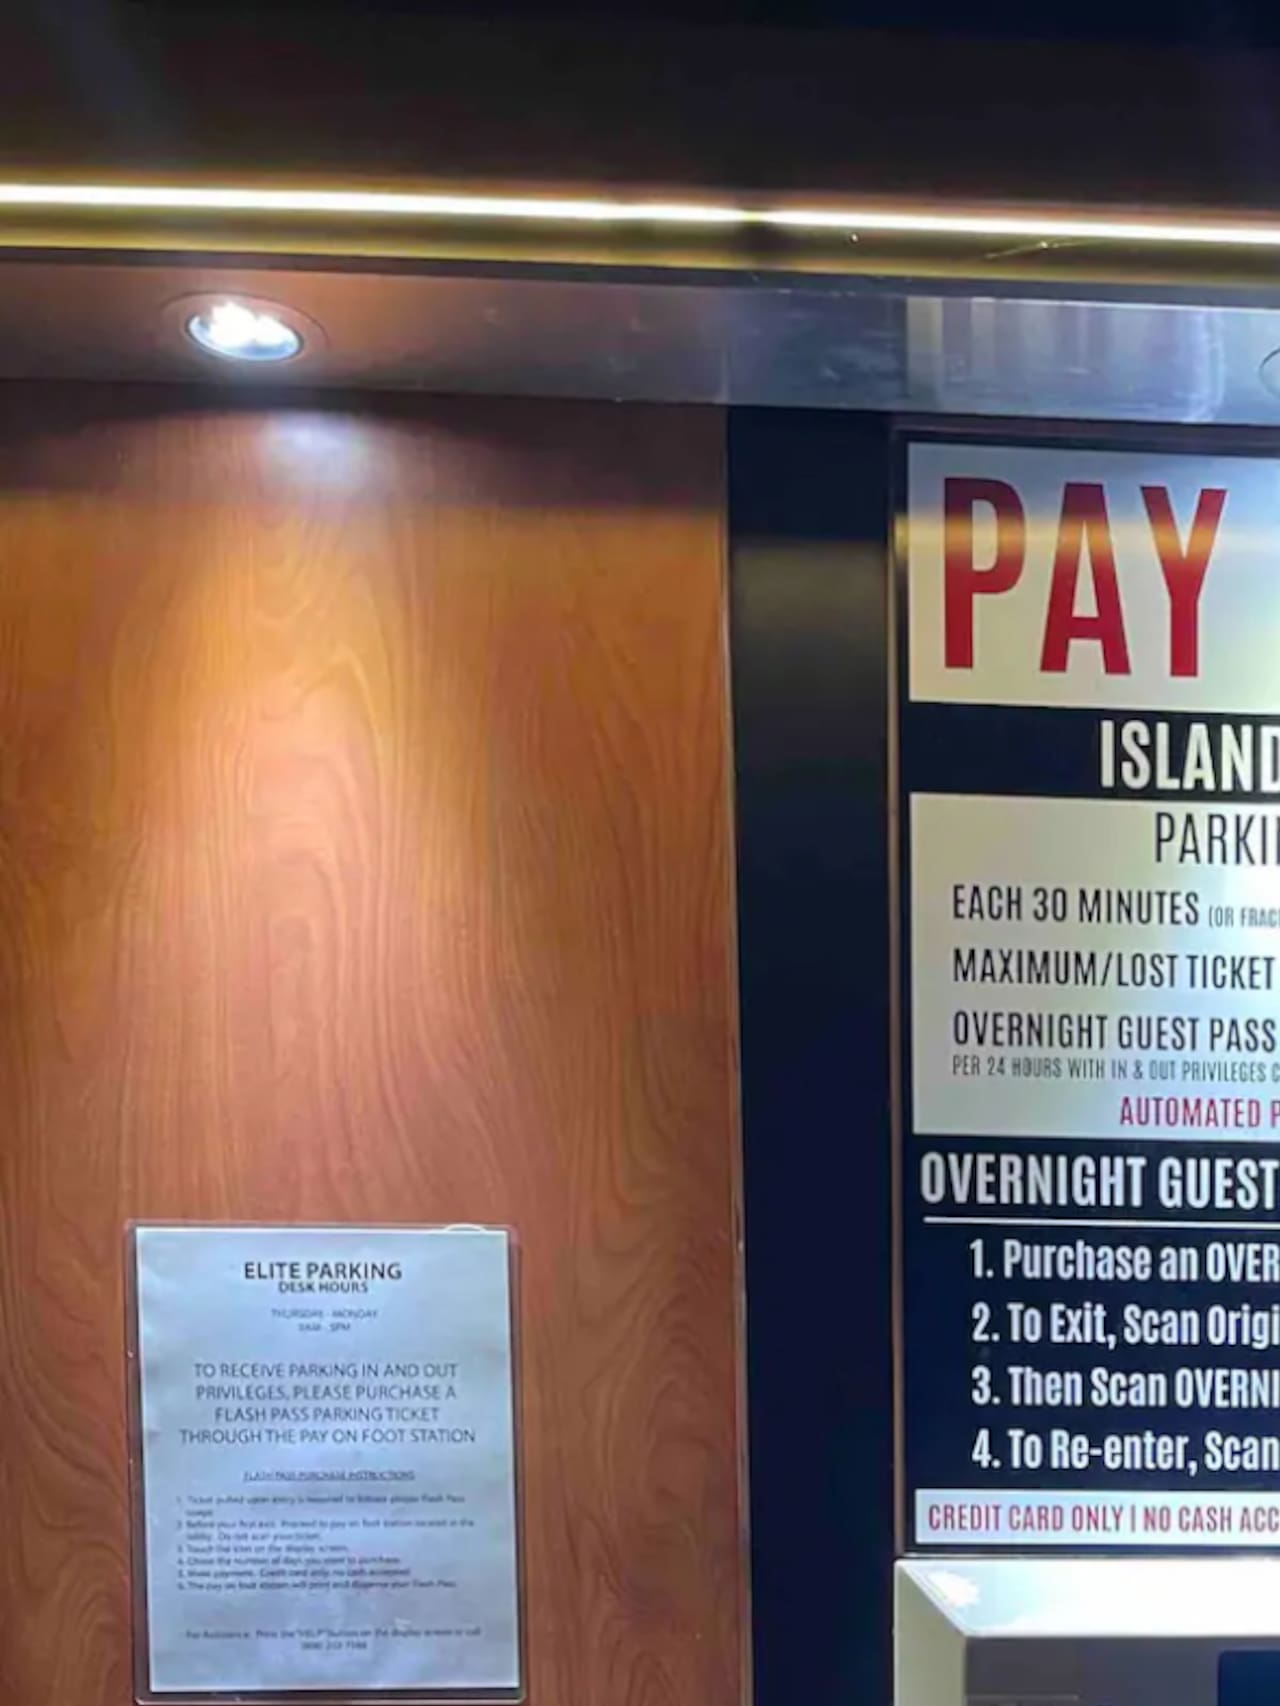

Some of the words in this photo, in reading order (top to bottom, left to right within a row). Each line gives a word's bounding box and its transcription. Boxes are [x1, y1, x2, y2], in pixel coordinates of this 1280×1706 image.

[943, 476, 1227, 677] PAY
[953, 884, 1022, 921] EACH
[1033, 887, 1067, 922] 30
[1079, 888, 1199, 925] MINUTES
[953, 948, 1179, 988] MAXIMUM/LOST
[1187, 953, 1275, 990] TICKET
[953, 1010, 1107, 1049] OVERNIGHT
[1118, 1015, 1199, 1051] GUEST
[1209, 1018, 1276, 1053] PASS
[952, 1054, 980, 1076] PER
[987, 1056, 1005, 1077] 24
[1012, 1056, 1061, 1078] HOURS
[1068, 1058, 1105, 1079] WITH
[1111, 1059, 1127, 1079] IN
[1133, 1059, 1143, 1080] &
[1149, 1059, 1175, 1081] OUT
[1182, 1060, 1267, 1082] PRIVILEGES
[1119, 1095, 1261, 1128] AUTOMATED
[921, 1152, 1147, 1207] OVERNIGHT
[1159, 1157, 1280, 1210] GUEST
[244, 1261, 300, 1280] ELITE
[306, 1261, 403, 1280] PARKING
[969, 1238, 994, 1278] 1.
[1003, 1238, 1151, 1281] Purchase
[1159, 1245, 1198, 1281] an
[278, 1281, 315, 1294] DESK
[318, 1281, 369, 1294] HOURS
[972, 1302, 1000, 1342] 2.
[1006, 1303, 1042, 1343] To
[1050, 1302, 1116, 1350] Exit,
[1123, 1303, 1199, 1345] Scan
[194, 1362, 216, 1378] TO
[220, 1362, 284, 1378] RECEIVE
[288, 1362, 357, 1379] PARKING
[362, 1363, 379, 1378] IN
[383, 1362, 420, 1378] AND
[423, 1362, 459, 1378] OUT
[971, 1365, 1000, 1405] 3.
[1007, 1366, 1083, 1407] Then
[1091, 1366, 1167, 1407] Scan
[293, 1384, 350, 1400] PLEASE
[355, 1384, 442, 1400] PURCHASE
[445, 1385, 456, 1400] A
[215, 1406, 266, 1422] FLASH
[270, 1406, 310, 1422] PASS
[313, 1406, 383, 1422] PARKING
[386, 1406, 440, 1422] TICKET
[179, 1428, 262, 1444] THROUGH
[266, 1428, 297, 1444] THE
[301, 1428, 329, 1444] PAY
[331, 1428, 358, 1444] ON
[362, 1428, 404, 1444] FOOT
[410, 1427, 476, 1444] STATION
[971, 1428, 1001, 1469] 4.
[1007, 1428, 1042, 1469] To
[1050, 1429, 1197, 1477] Re-enter,
[1204, 1430, 1280, 1471] Scan
[928, 1503, 1002, 1531] CREDIT
[1008, 1504, 1063, 1532] CARD
[1071, 1504, 1123, 1532] ONLY
[1144, 1505, 1171, 1532] NO
[1178, 1505, 1232, 1533] CASH
